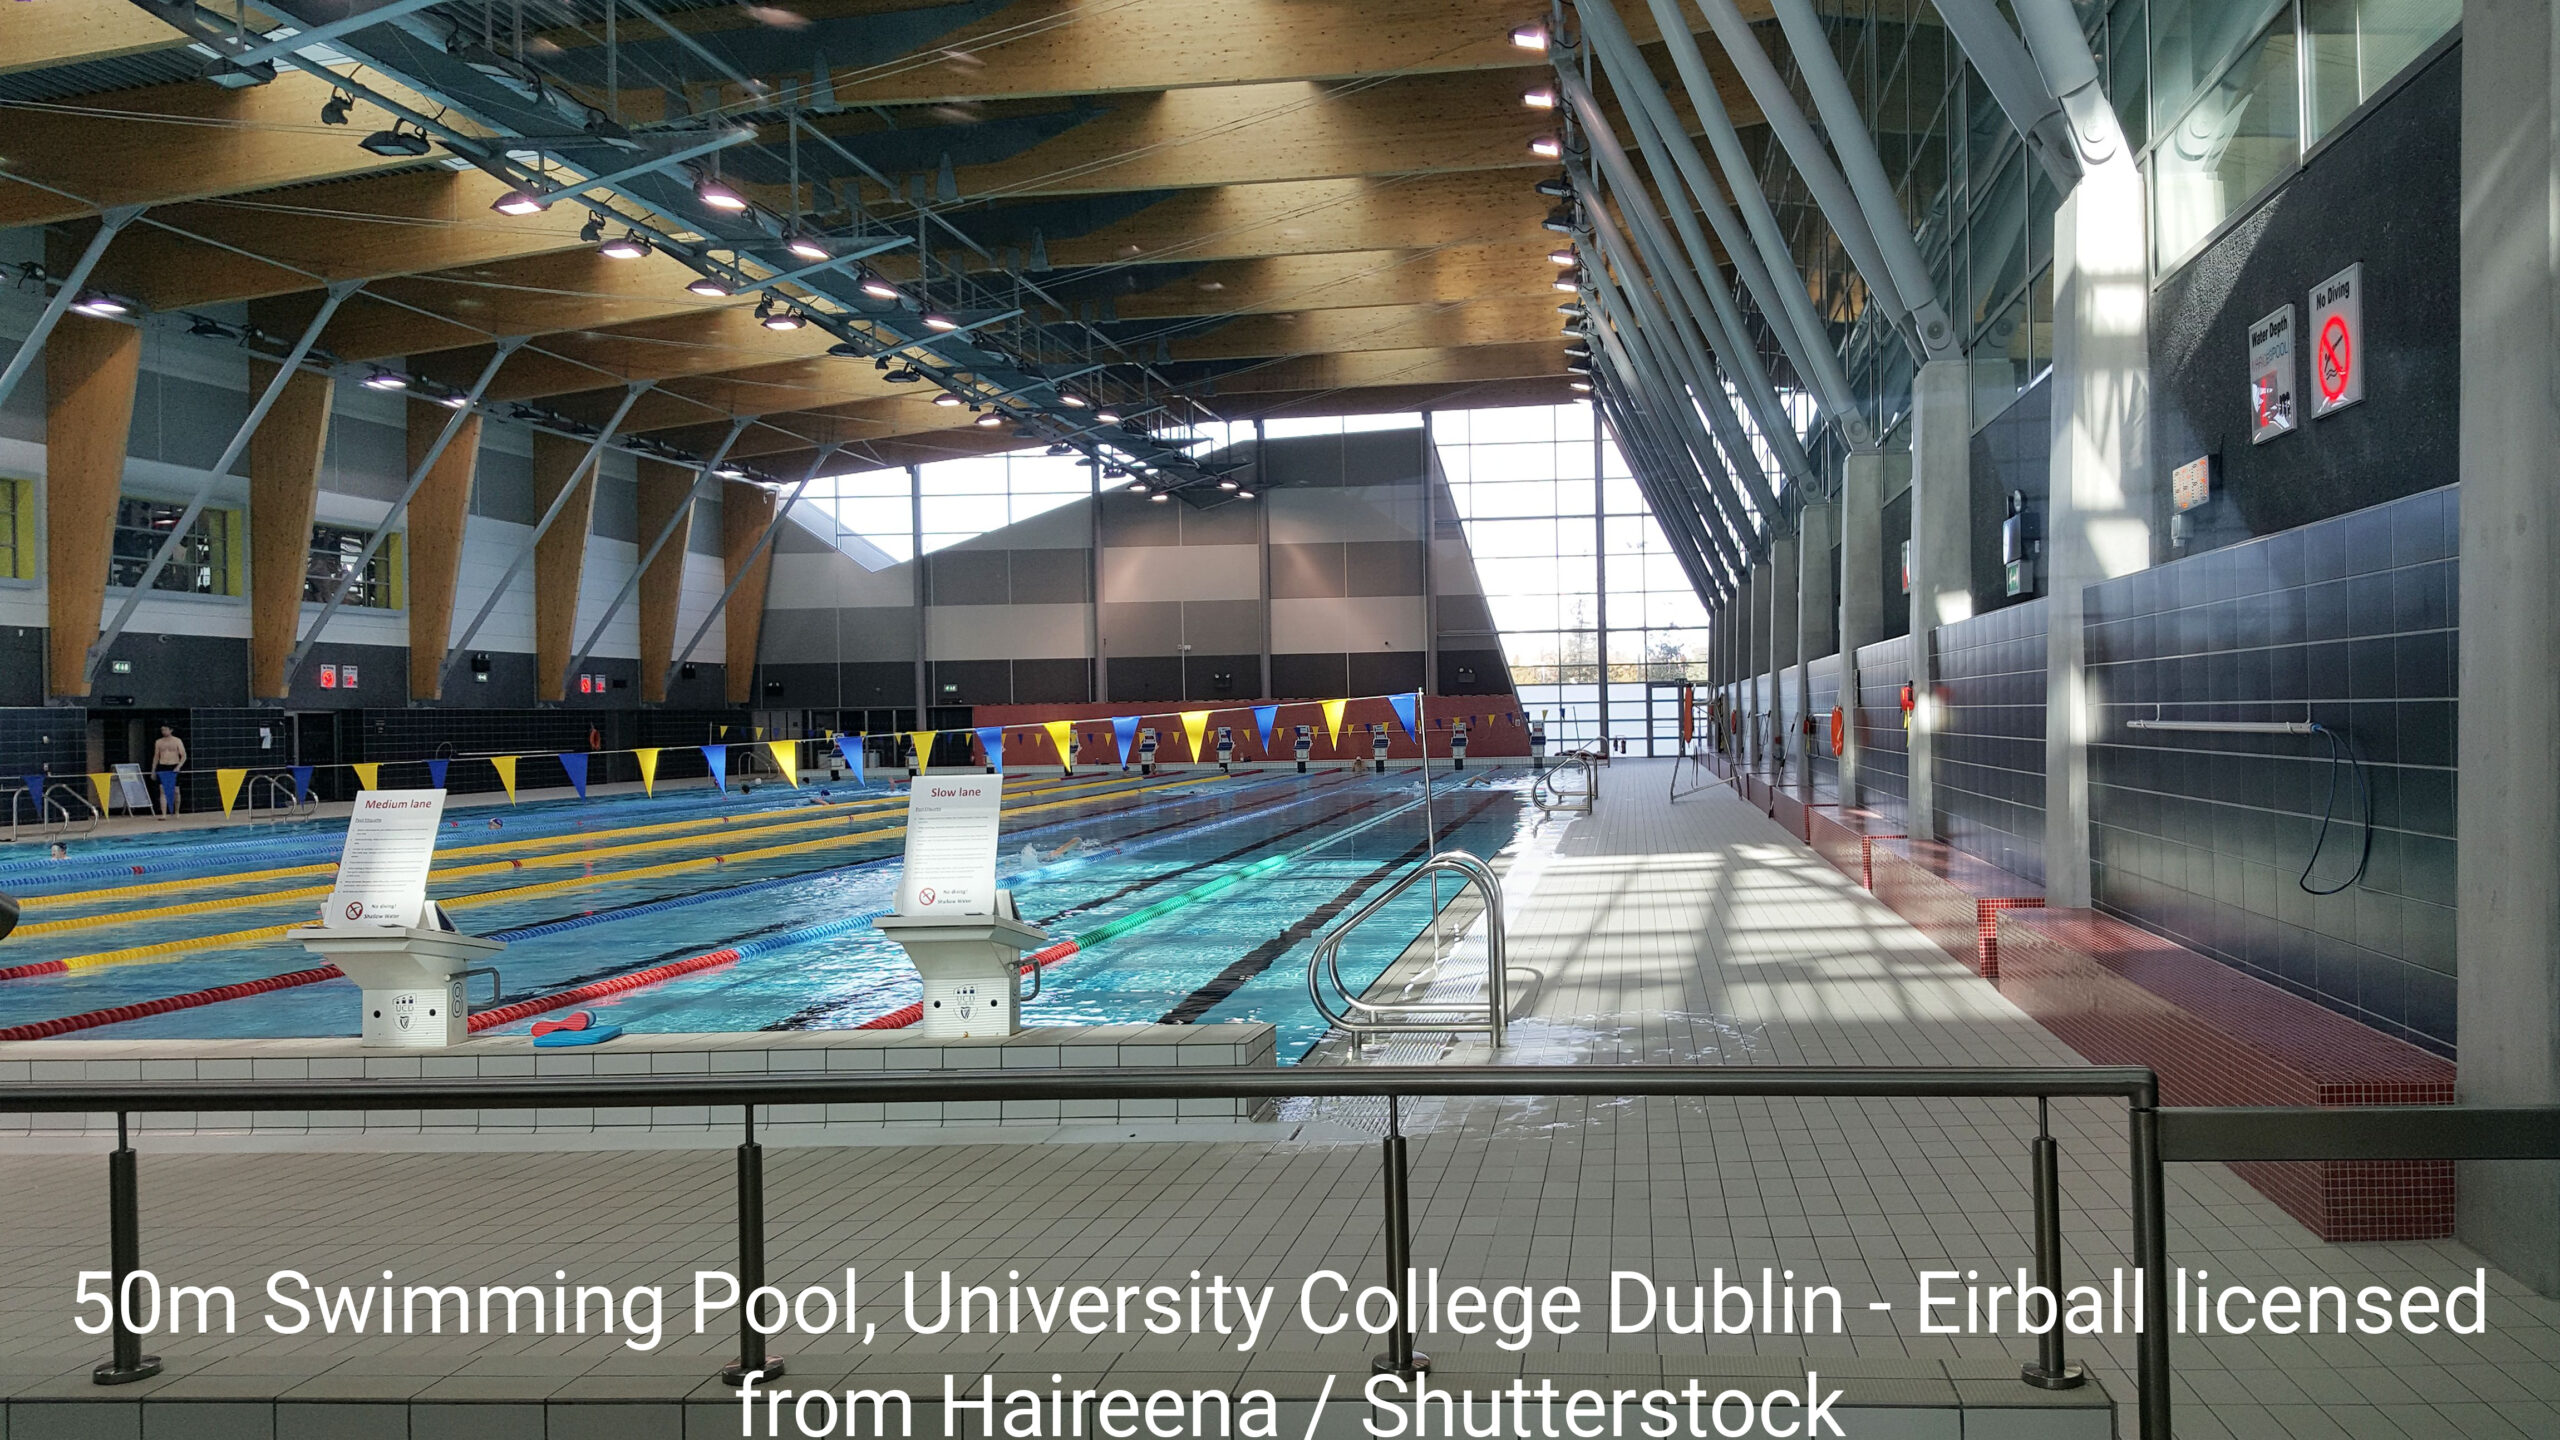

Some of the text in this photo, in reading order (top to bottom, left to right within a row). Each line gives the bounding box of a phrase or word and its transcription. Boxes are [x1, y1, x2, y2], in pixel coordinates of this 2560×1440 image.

[2316, 280, 2350, 311] No Diving
[2251, 315, 2288, 348] Water Depth
[931, 787, 982, 798] Slow lane
[365, 799, 432, 809] Medium lane
[395, 1004, 415, 1013] UCD
[451, 981, 464, 1019] 8
